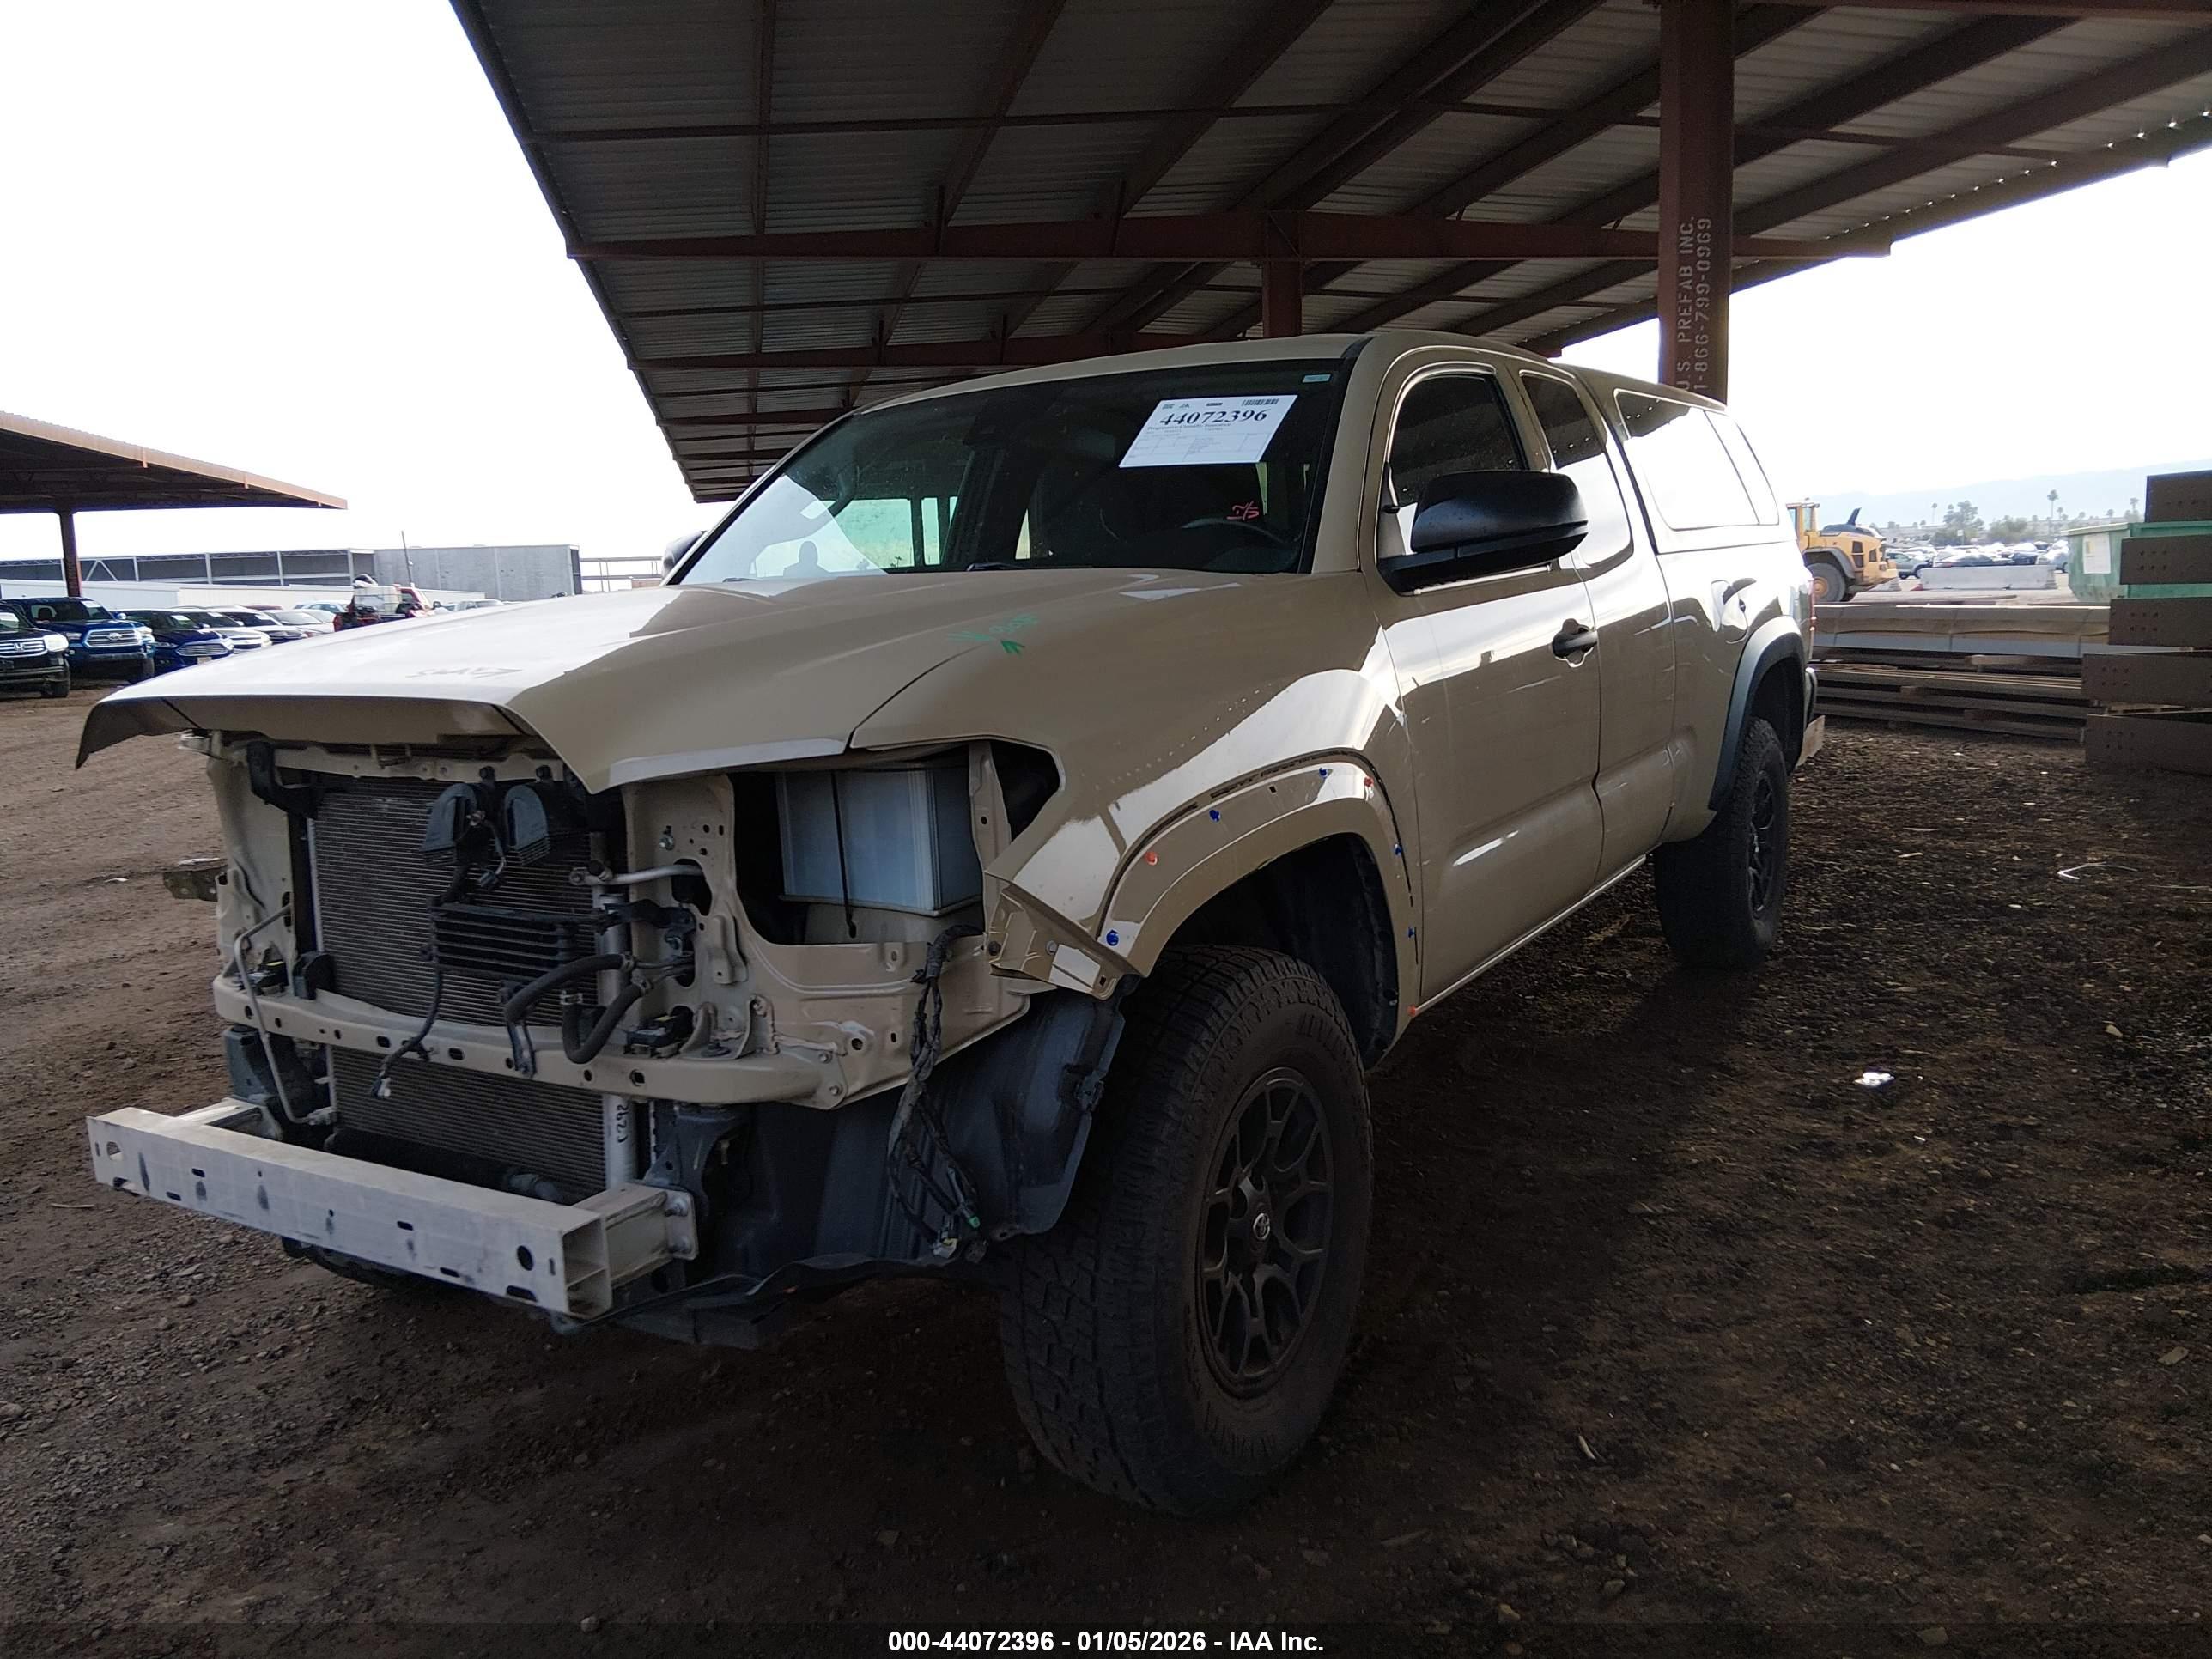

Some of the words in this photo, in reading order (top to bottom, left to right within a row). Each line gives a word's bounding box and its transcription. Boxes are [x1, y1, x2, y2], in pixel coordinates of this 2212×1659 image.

[1679, 216, 1694, 254] INC.
[1677, 265, 1692, 343] PREFAB
[1693, 218, 1711, 390] 1-866-799-0969
[1159, 409, 1271, 425] 44072396
